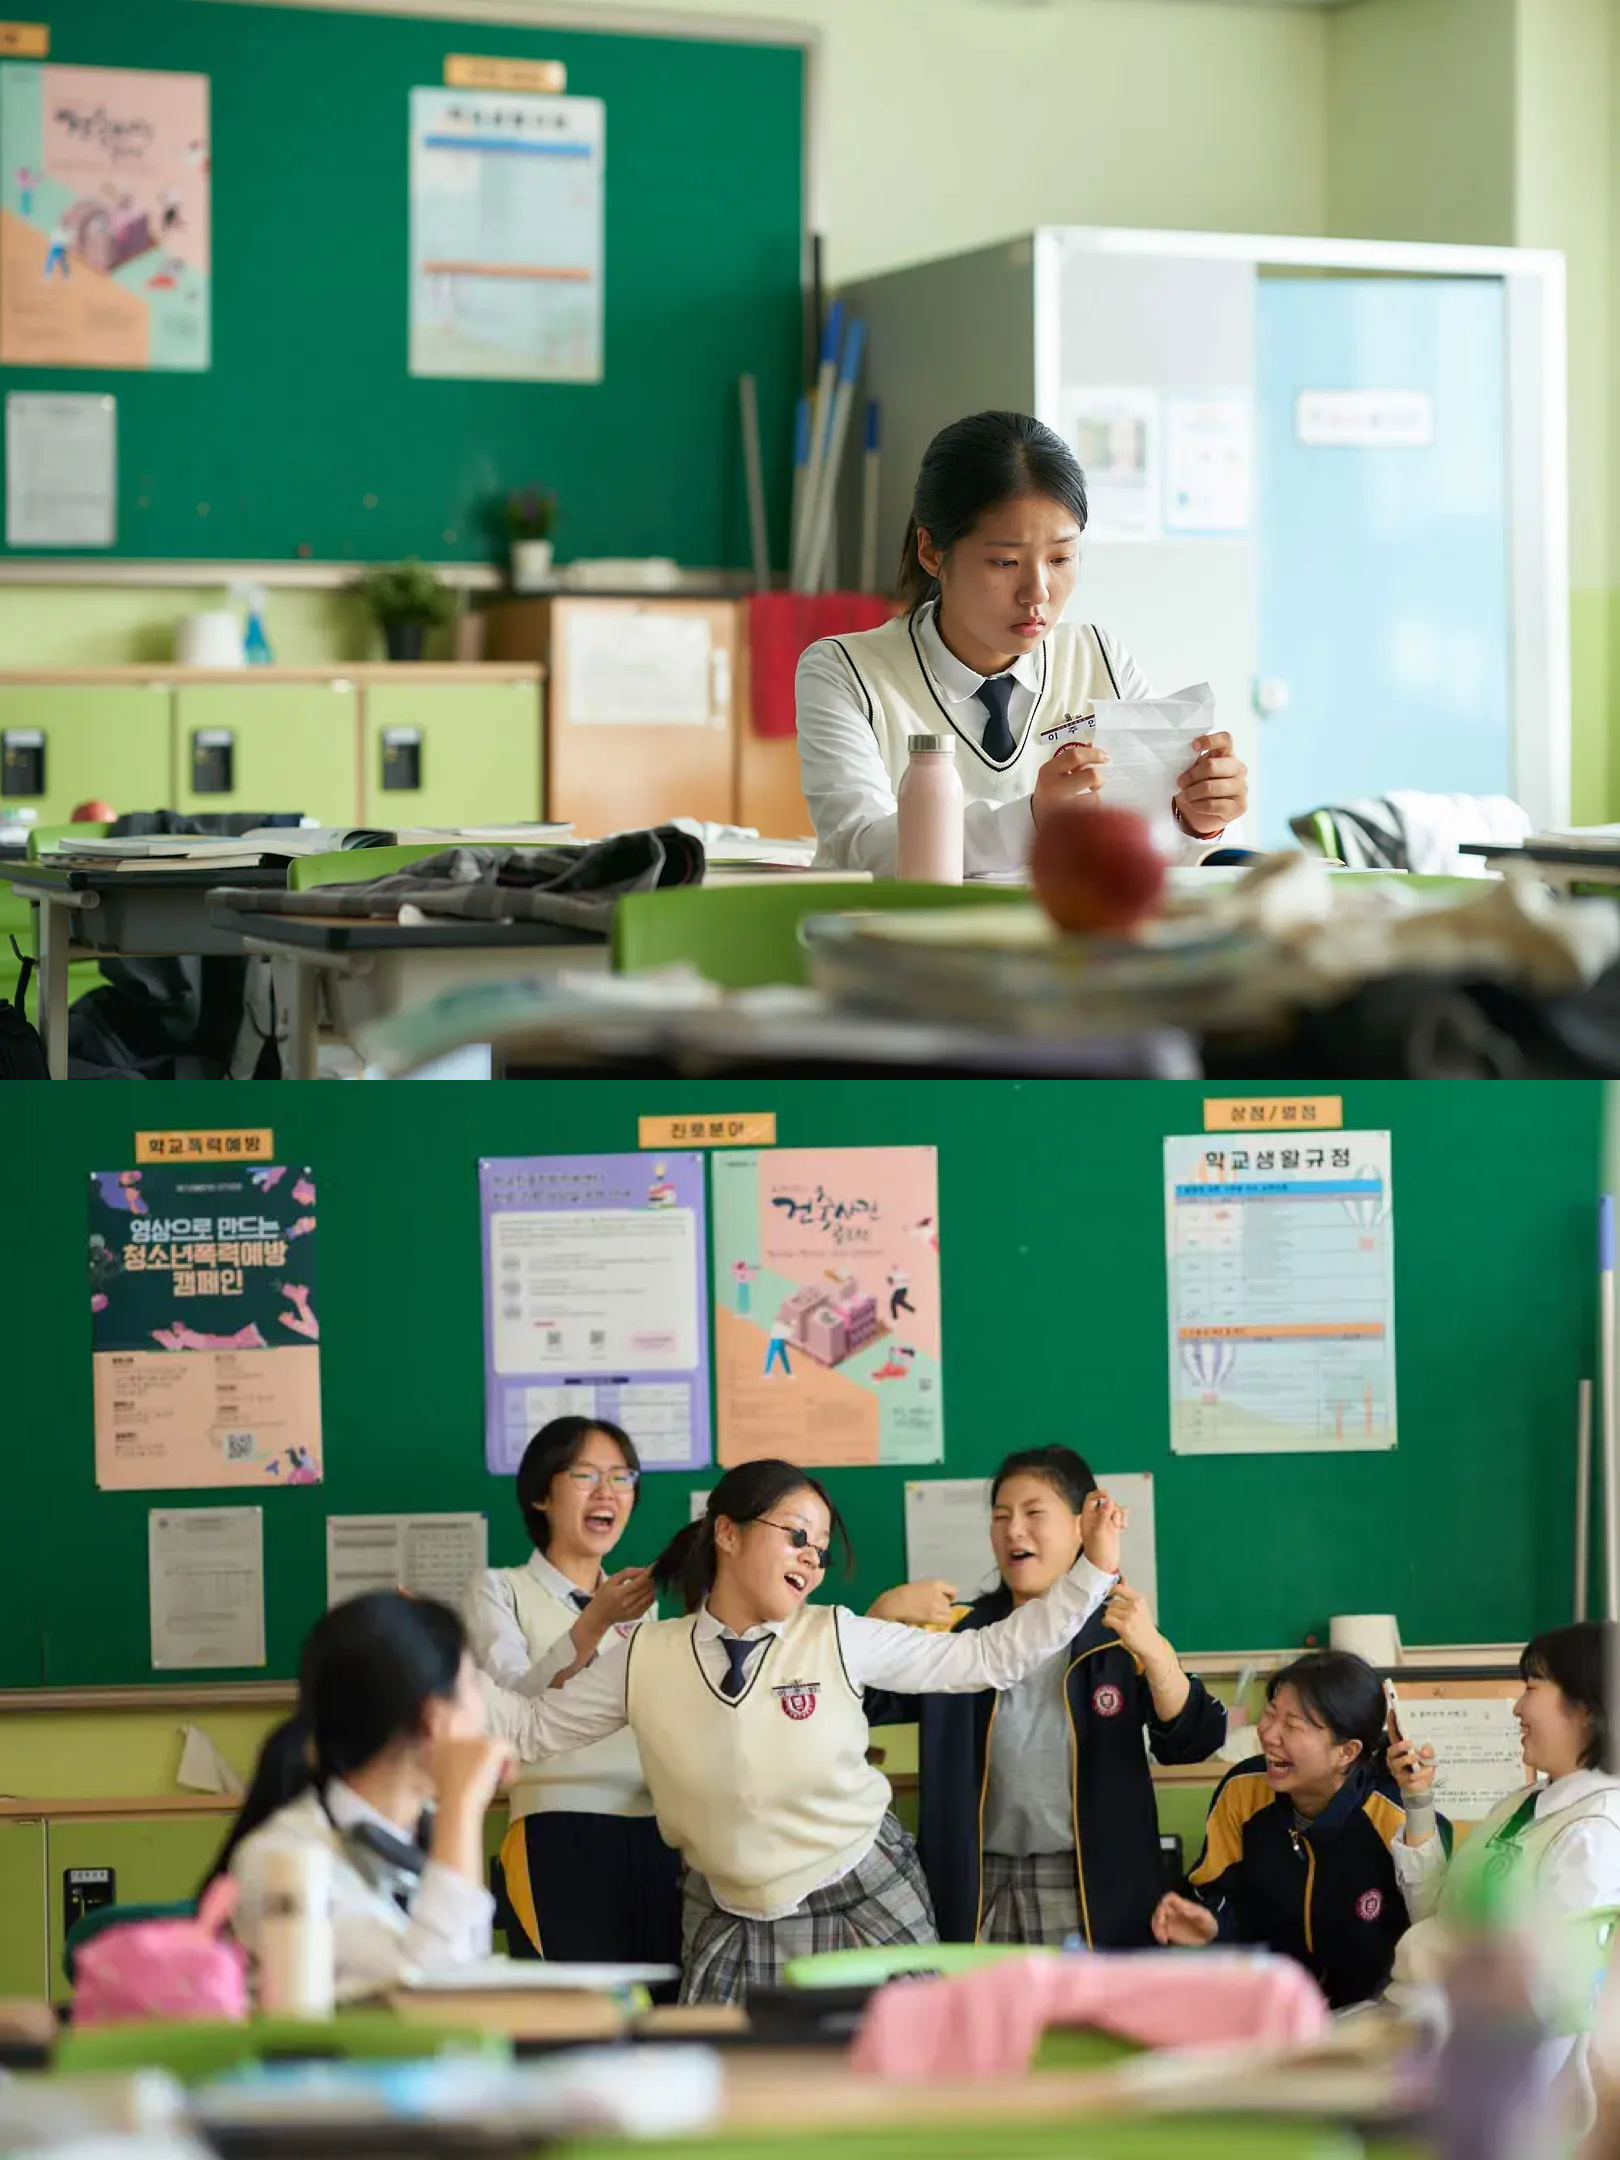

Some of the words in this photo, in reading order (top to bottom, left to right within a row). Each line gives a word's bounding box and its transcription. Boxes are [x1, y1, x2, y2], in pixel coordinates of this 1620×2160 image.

[671, 1121, 744, 1139] 진로분야
[149, 1136, 260, 1155] 학교폭력예방
[1205, 1147, 1350, 1170] 학교생활규정
[130, 1217, 214, 1243] 영상으로
[217, 1216, 280, 1241] 만드는
[123, 1241, 288, 1271] 청소년폭력예방
[172, 1269, 243, 1297] 캠페인
